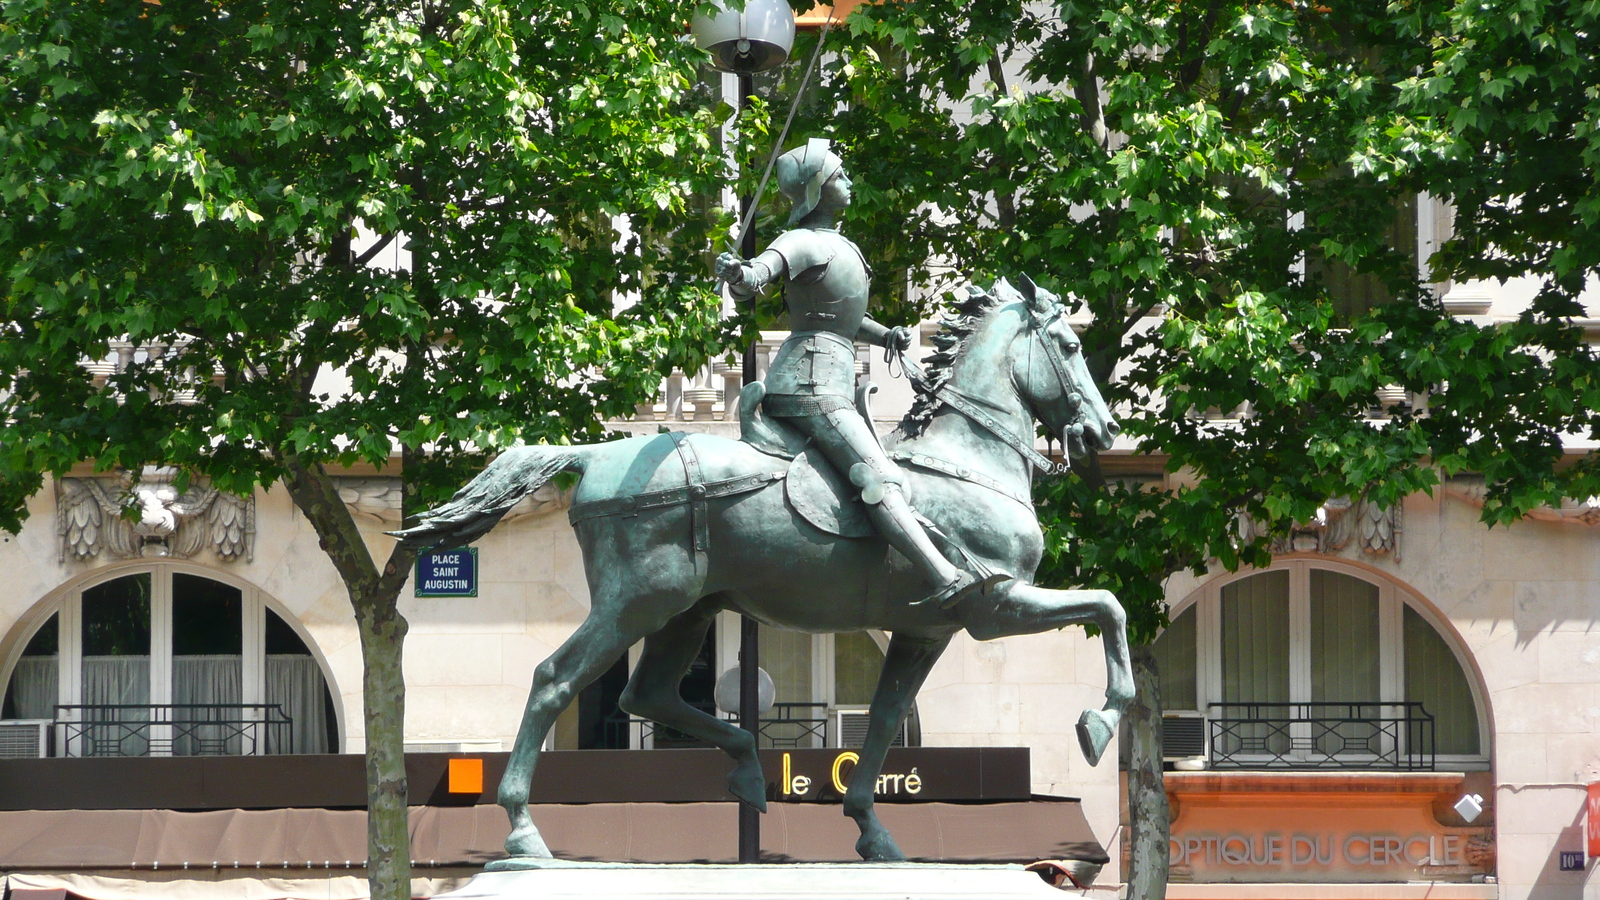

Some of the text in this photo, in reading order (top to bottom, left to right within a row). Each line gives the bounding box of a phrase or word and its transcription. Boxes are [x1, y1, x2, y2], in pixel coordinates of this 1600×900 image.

[432, 555, 460, 564] PLACE
[433, 567, 459, 577] SAINT
[424, 580, 468, 590] AUGUSTIN
[782, 752, 811, 795] le
[1291, 836, 1335, 866] DU
[1342, 835, 1459, 866] CERCLE
[1563, 854, 1575, 869] 10
